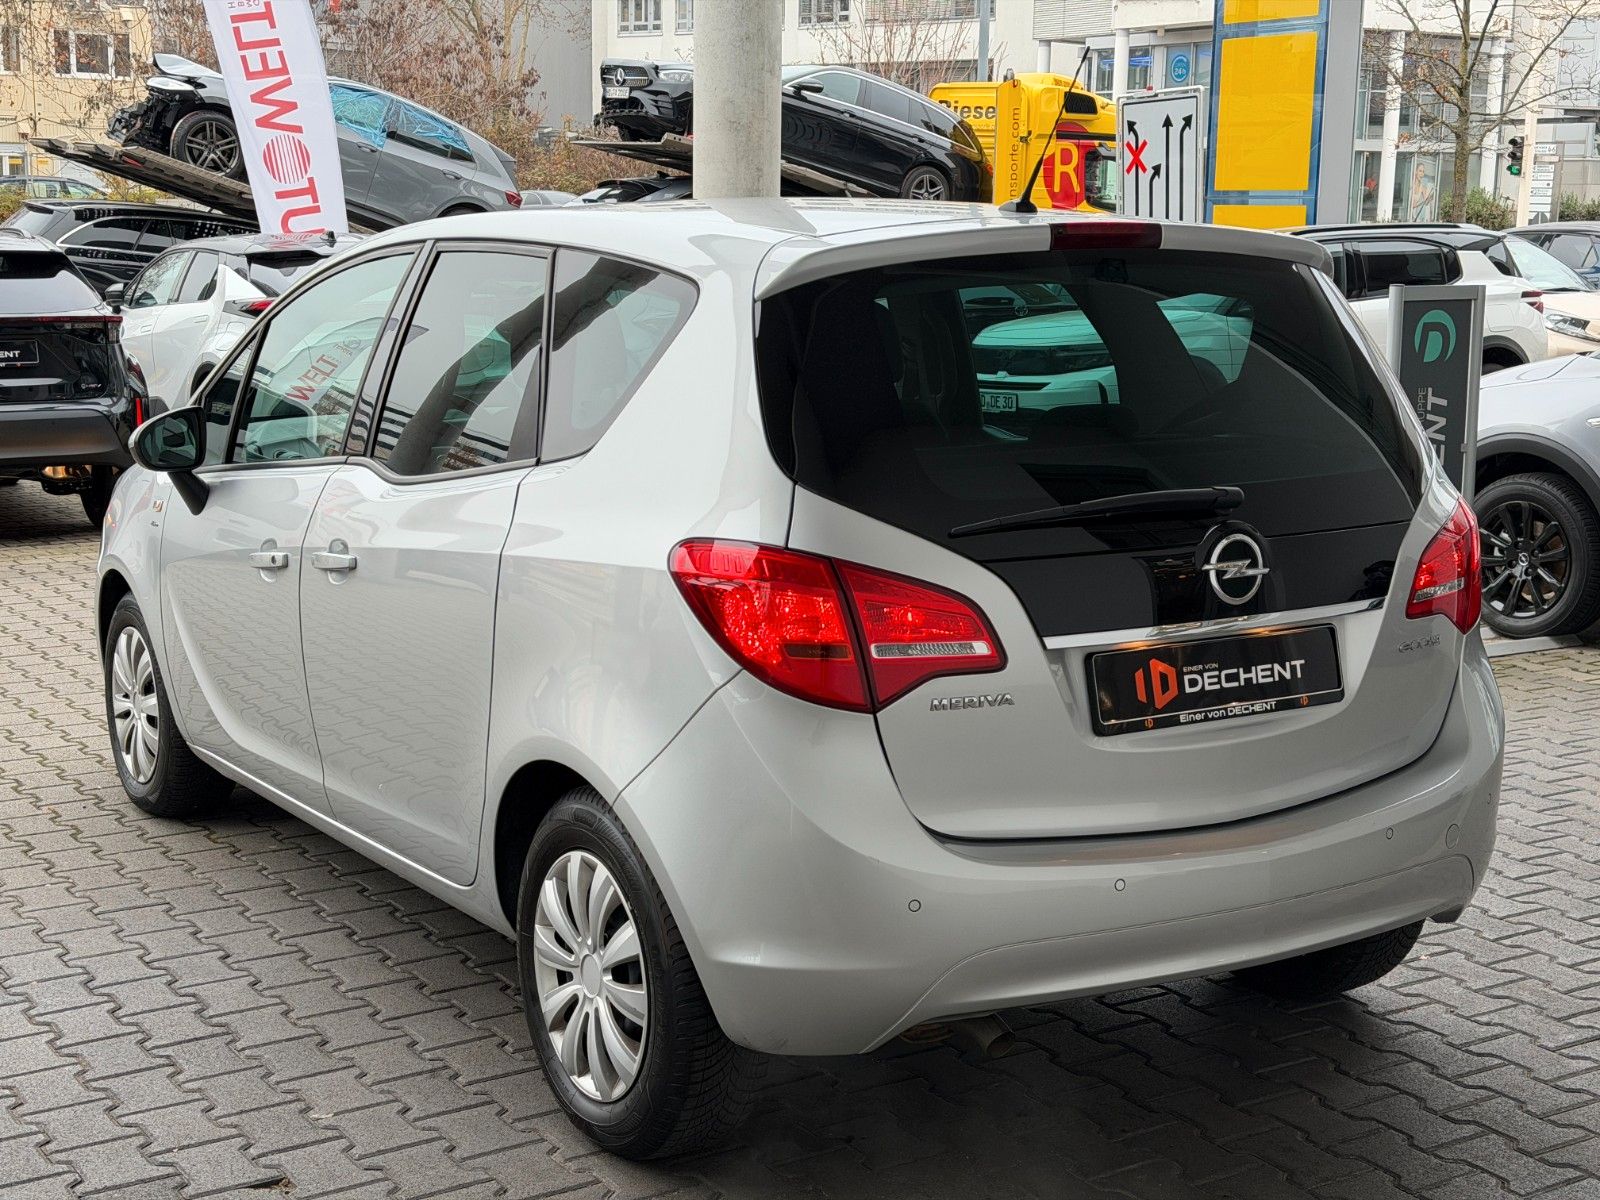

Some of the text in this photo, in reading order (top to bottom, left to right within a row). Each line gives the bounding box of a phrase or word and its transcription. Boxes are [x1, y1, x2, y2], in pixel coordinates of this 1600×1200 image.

[1054, 141, 1080, 193] R
[285, 354, 338, 400] WELT
[1002, 396, 1013, 409] 30
[1183, 662, 1219, 673] EINER VON
[1183, 659, 1305, 694] DECHENT
[929, 693, 1015, 712] MERIVA
[1179, 701, 1277, 723] Einer von DECHENT
